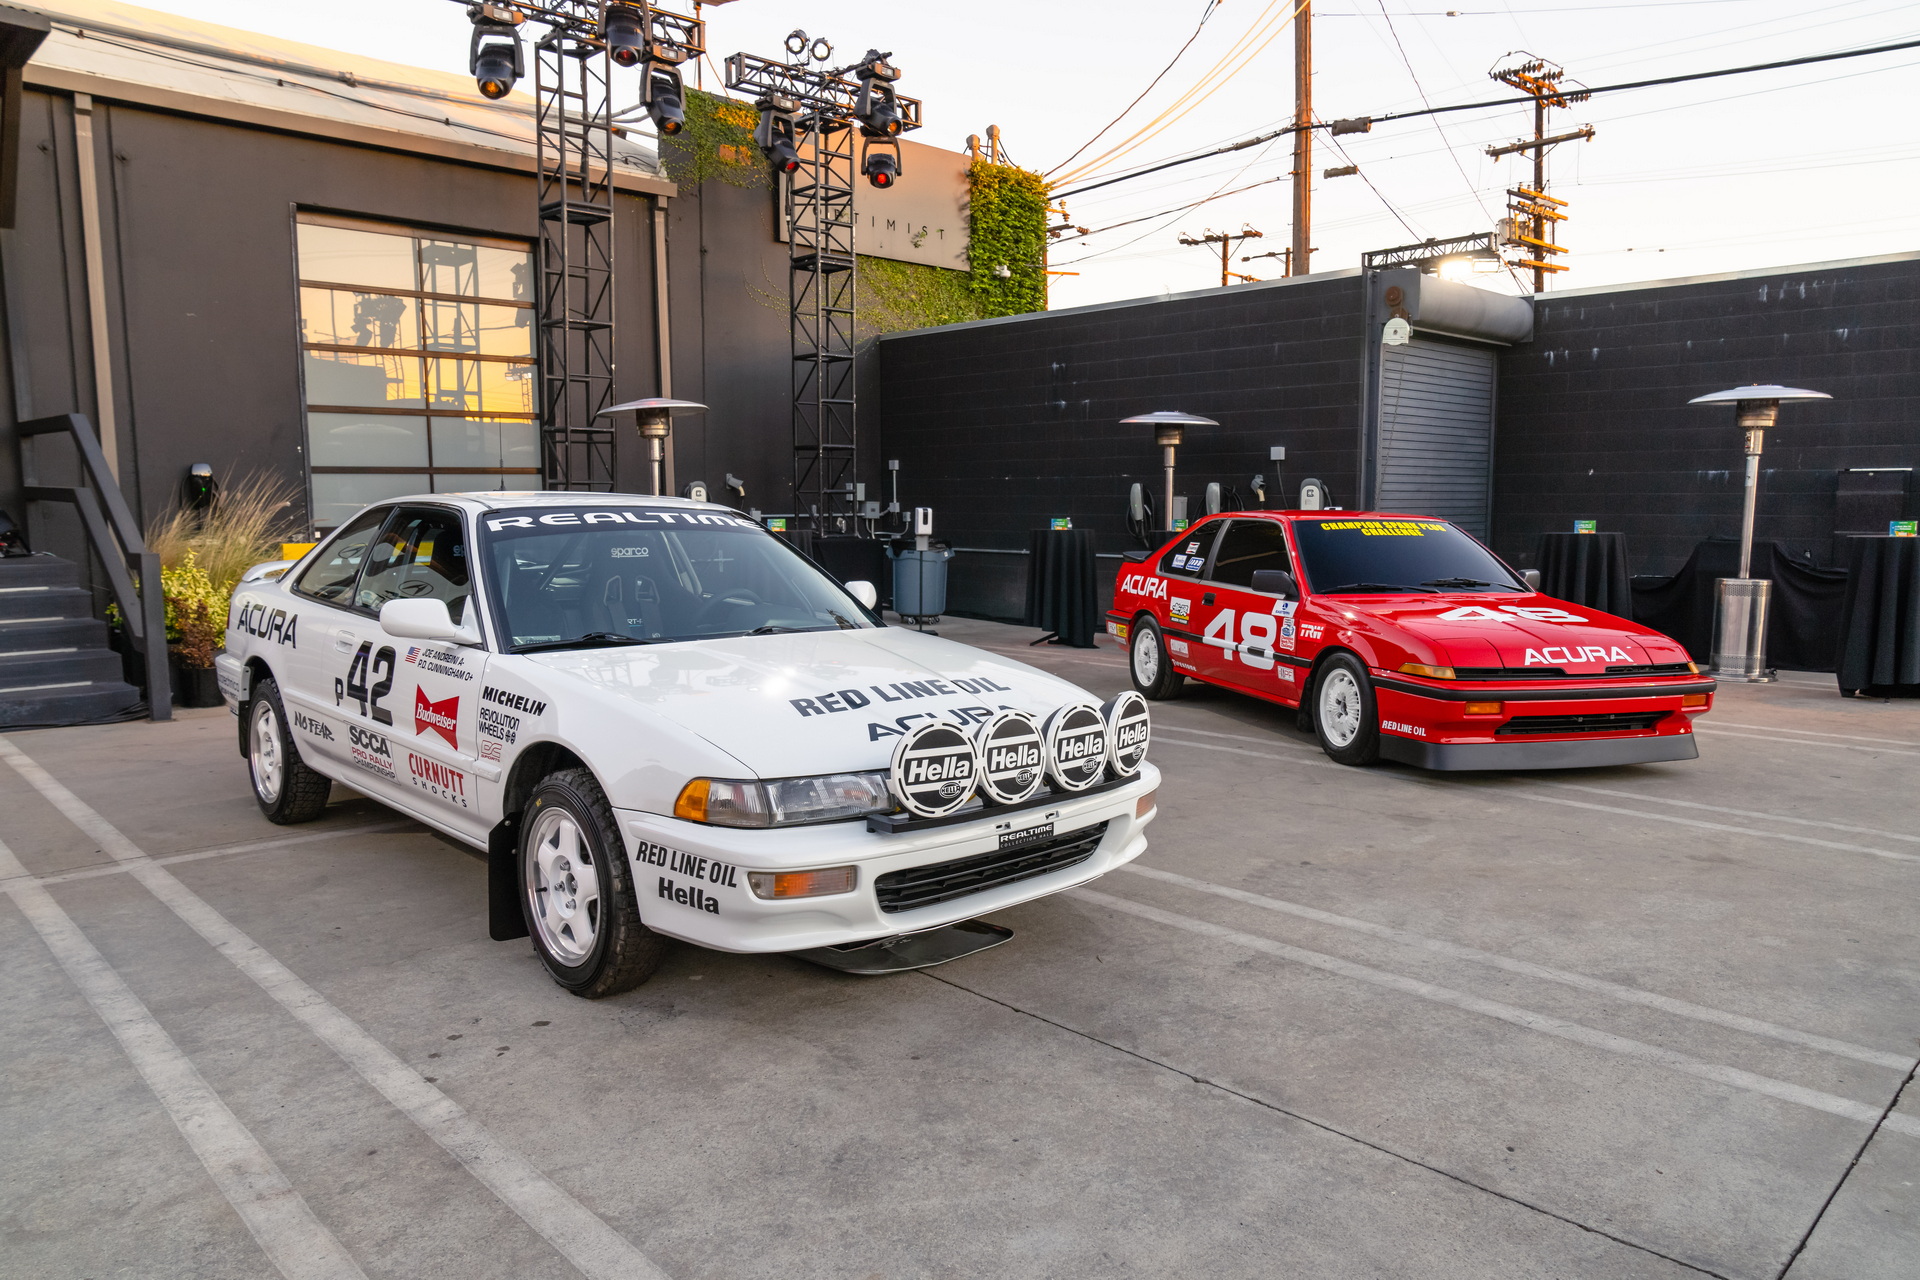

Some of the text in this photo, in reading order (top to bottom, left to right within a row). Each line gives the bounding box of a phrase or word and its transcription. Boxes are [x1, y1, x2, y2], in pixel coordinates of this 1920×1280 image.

[486, 512, 766, 532] REALTIME
[1320, 521, 1446, 532] CHAMPION SPARK PLUG
[1361, 528, 1424, 537] CHALLENGE
[611, 546, 649, 558] sparco
[1121, 573, 1168, 600] ACURA
[237, 601, 298, 649] ACURA
[1437, 605, 1589, 623] 48
[1202, 608, 1277, 671] 48
[1300, 623, 1325, 640] TRW
[422, 648, 434, 658] JOE
[432, 650, 460, 666] ANDREINI
[1524, 646, 1634, 666] ACURA
[417, 659, 427, 670] P.D.
[427, 661, 466, 680] CUNNINGHAM
[482, 686, 547, 717] MICHELIN
[789, 677, 1012, 717] RED LINE OIL
[294, 711, 335, 741] NO FEAR
[416, 703, 457, 730] Budweiser
[479, 707, 520, 732] REVOLUTION
[1381, 720, 1427, 737] RED LINE OIL
[349, 725, 392, 759] SCCA
[478, 719, 504, 741] WHEELS
[1118, 722, 1147, 748] Hella
[351, 746, 393, 771] PRO RALLY
[481, 754, 501, 763] SPORTS
[990, 744, 1039, 771] Hella
[1060, 734, 1103, 761] Hella
[353, 755, 396, 779] CHAMPIONSHIP
[408, 752, 464, 797] CURNUTT
[907, 756, 970, 783] Hella
[1000, 824, 1053, 843] REALTIME
[1000, 831, 1052, 848] COLLECTION HALL
[636, 840, 737, 888] RED LINE OIL
[658, 876, 720, 915] Hella
